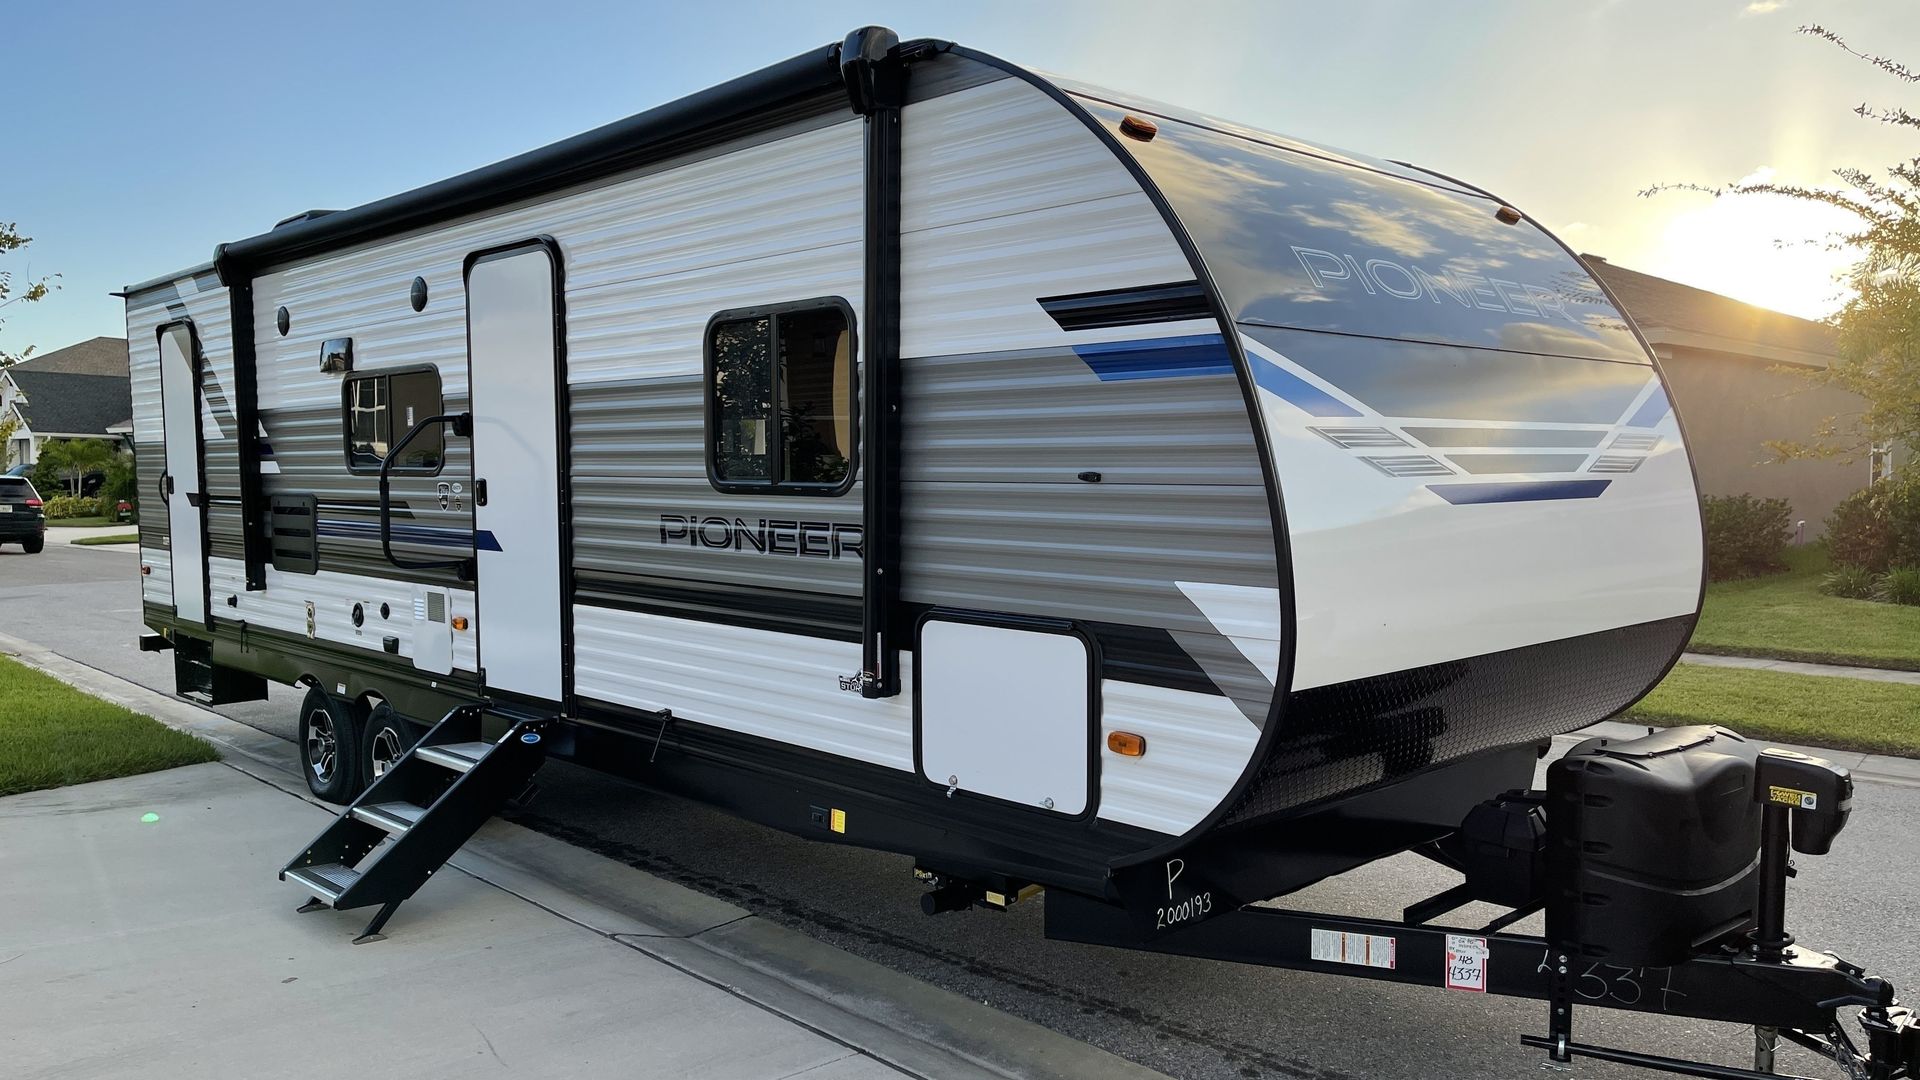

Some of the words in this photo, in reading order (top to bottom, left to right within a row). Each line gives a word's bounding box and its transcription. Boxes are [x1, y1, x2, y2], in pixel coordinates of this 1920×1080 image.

[1291, 246, 1580, 325] PIONEER
[660, 514, 863, 560] PIONEER
[1166, 858, 1185, 900] P
[1156, 891, 1212, 930] 2000193
